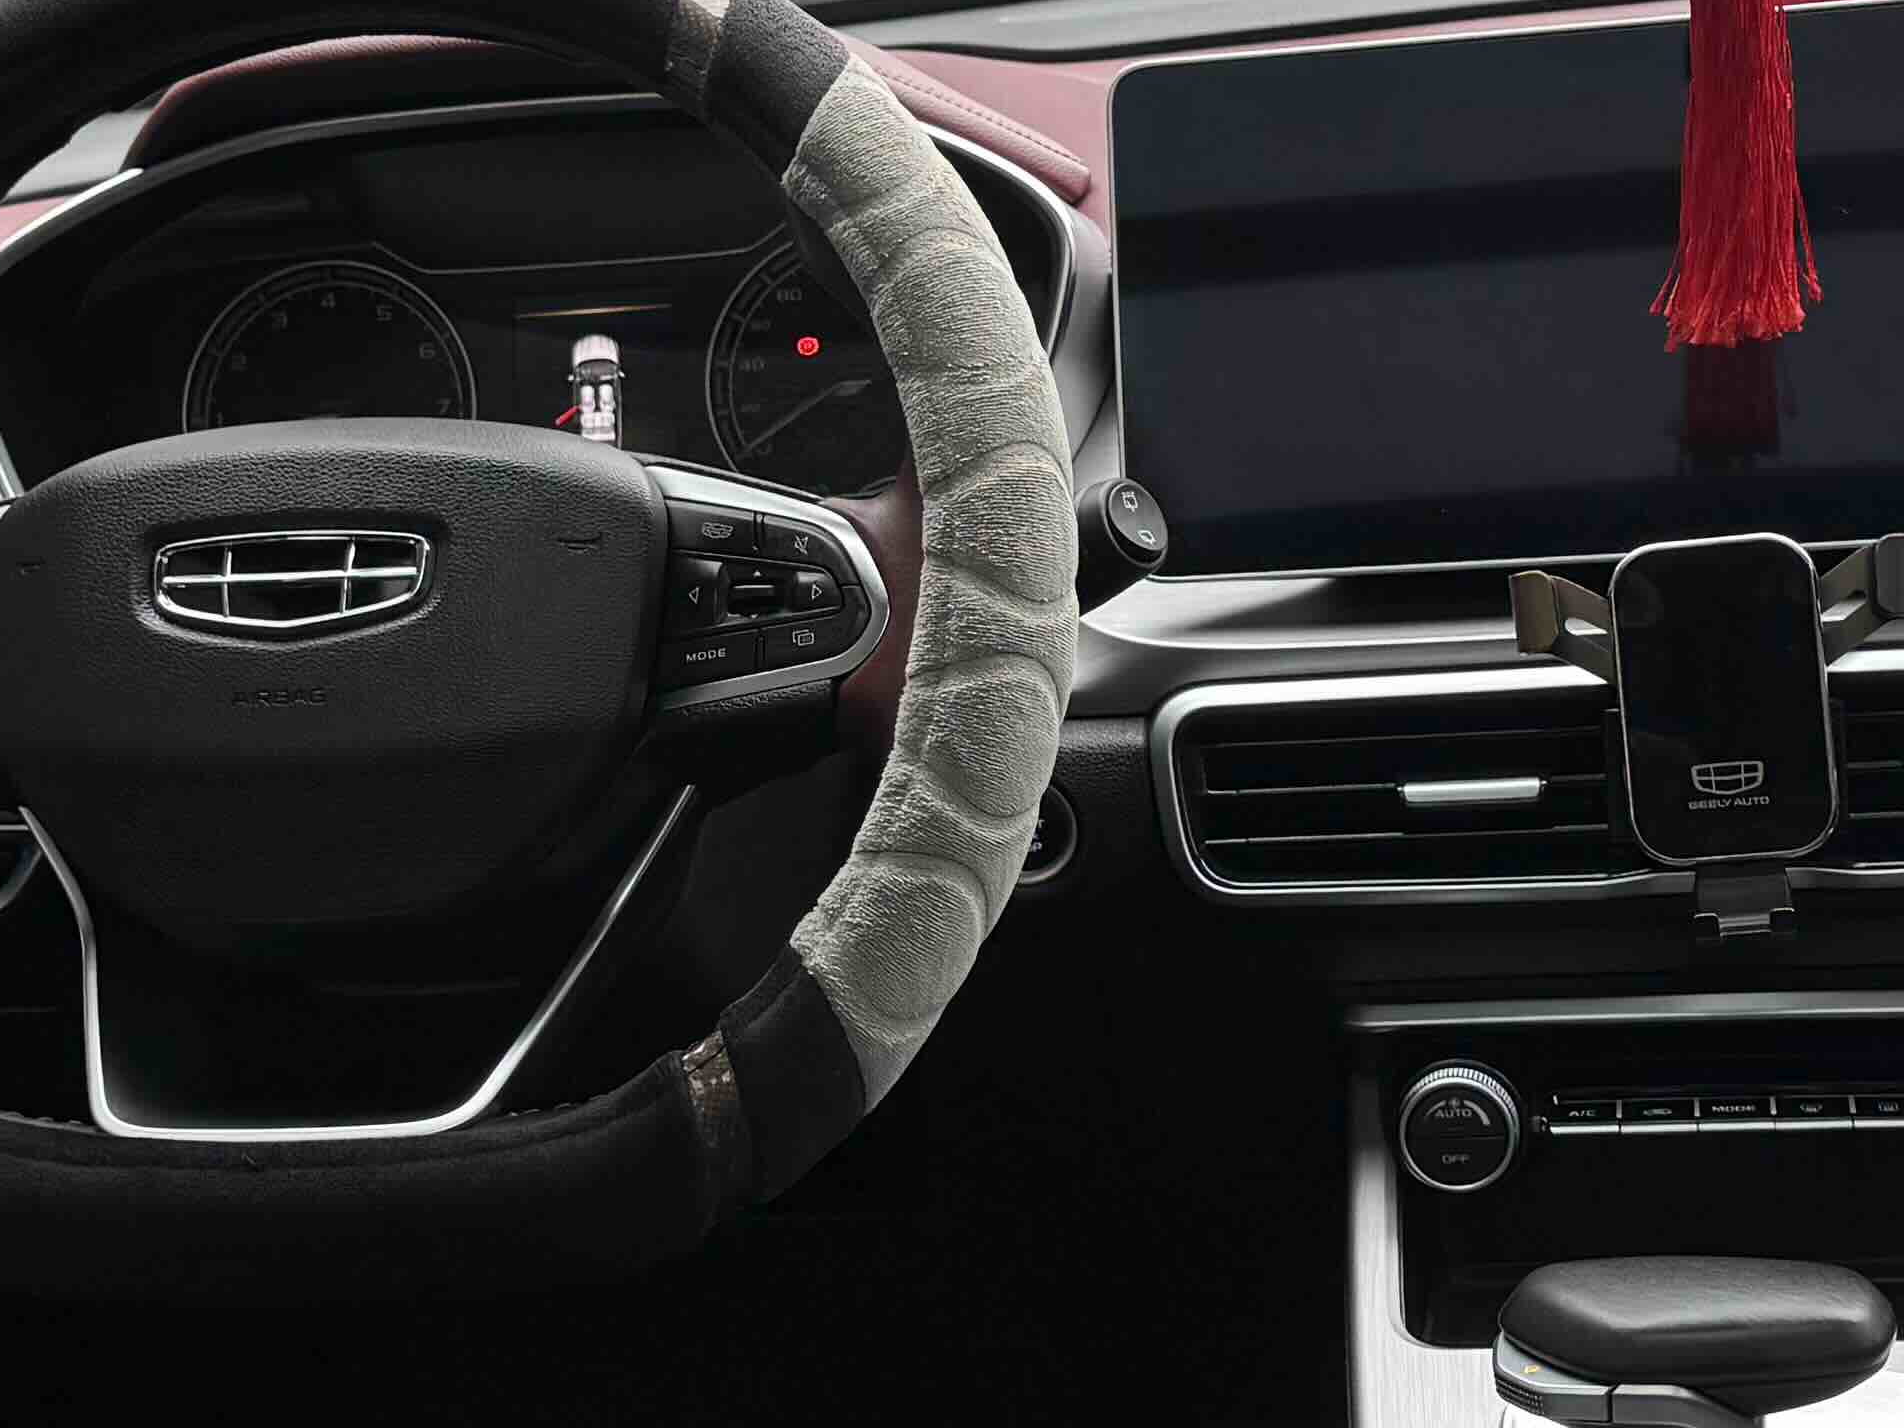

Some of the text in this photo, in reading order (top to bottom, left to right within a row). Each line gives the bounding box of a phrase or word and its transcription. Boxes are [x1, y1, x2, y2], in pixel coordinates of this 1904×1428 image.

[685, 647, 727, 662] MODE
[232, 688, 328, 709] AIRBAG
[1734, 795, 1770, 806] AUTO
[1434, 1108, 1473, 1119] AUTO
[1711, 1104, 1757, 1114] MODE
[1441, 1154, 1471, 1165] OFF
